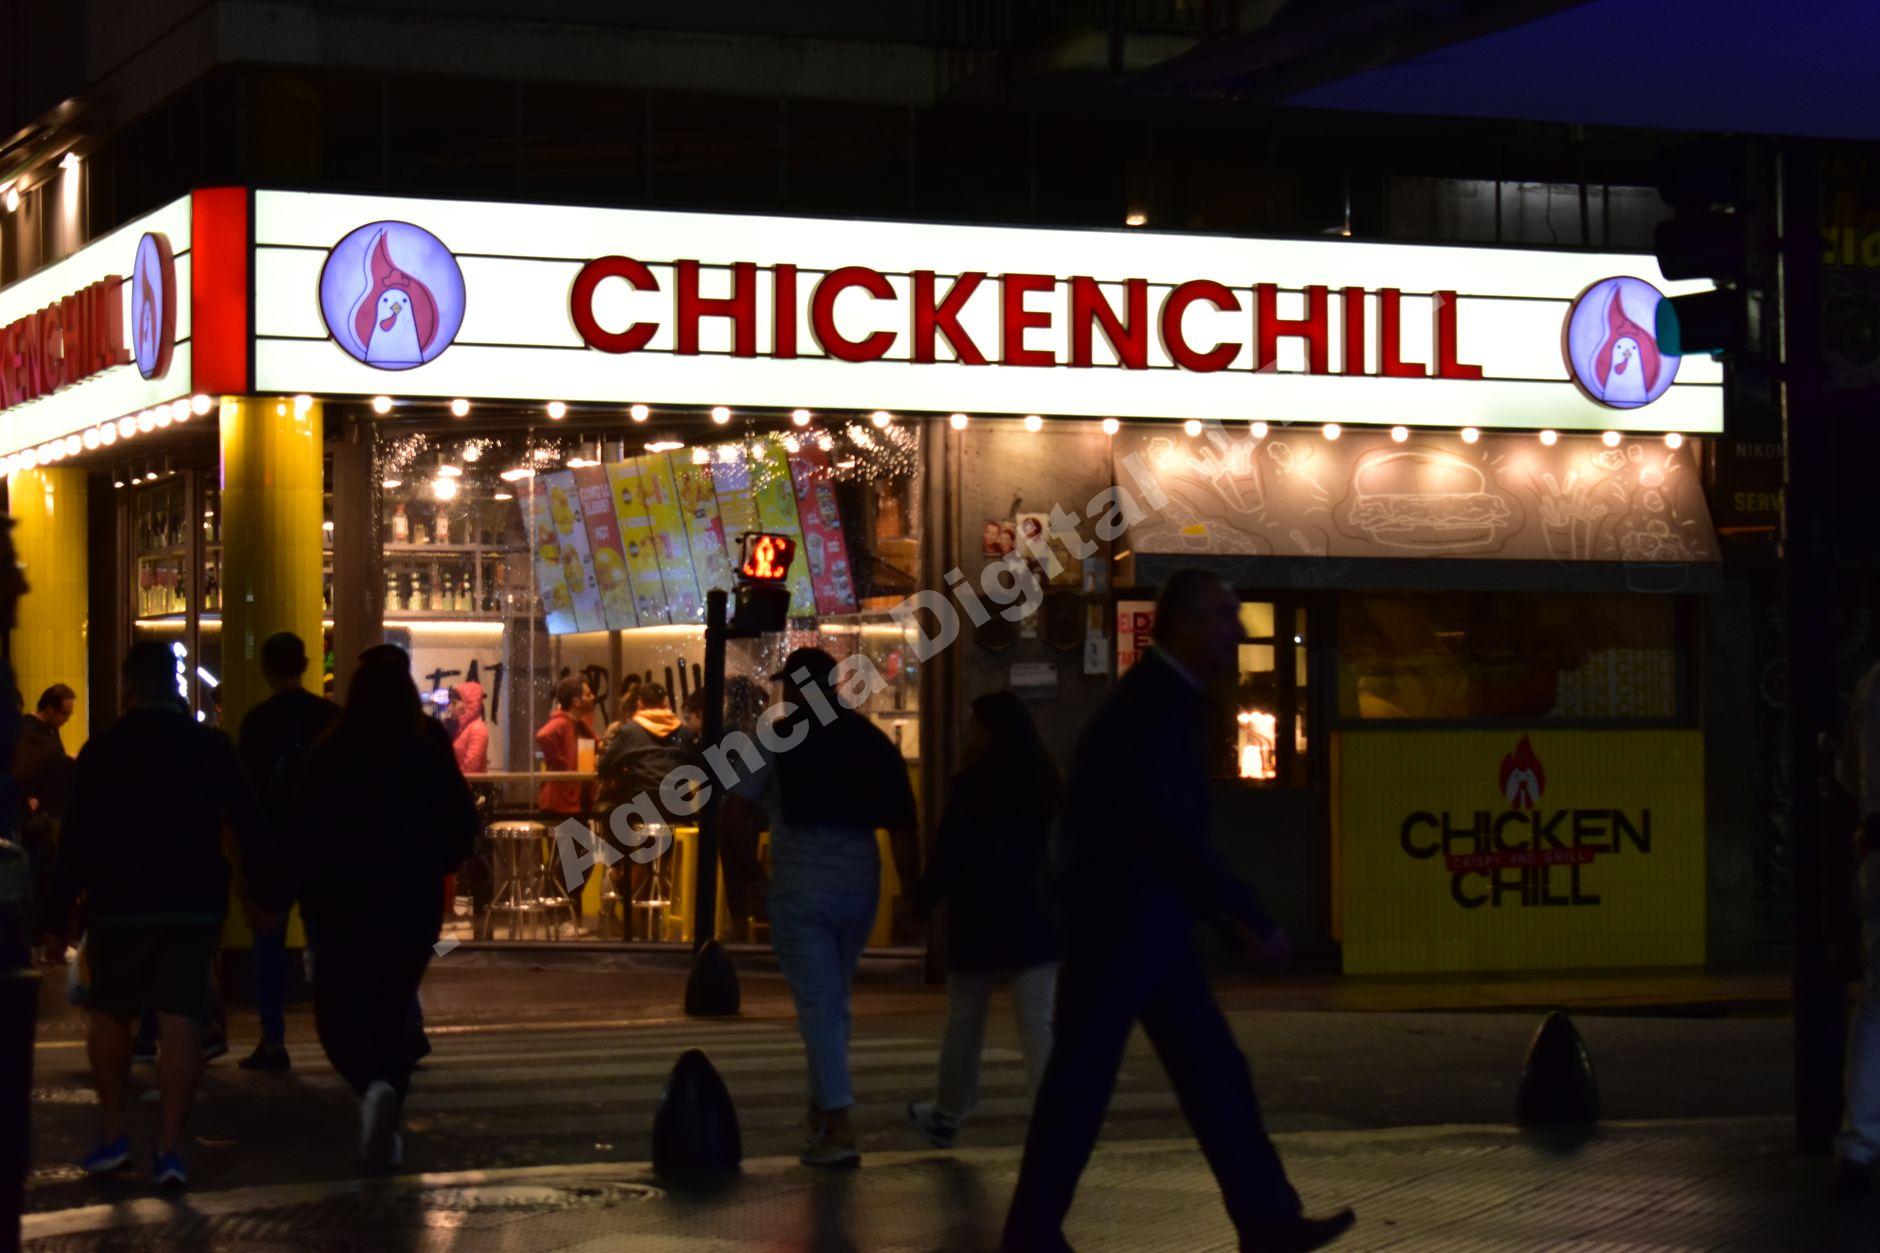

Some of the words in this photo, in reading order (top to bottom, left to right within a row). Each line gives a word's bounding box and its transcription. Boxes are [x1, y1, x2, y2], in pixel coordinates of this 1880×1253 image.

[571, 255, 1482, 380] CHICKENCHILL
[1400, 809, 1652, 860] CHICKEN
[1452, 854, 1501, 869] CRISPY
[1511, 853, 1536, 866] AND
[1544, 850, 1586, 864] GRILL
[1451, 864, 1601, 910] CHILL
